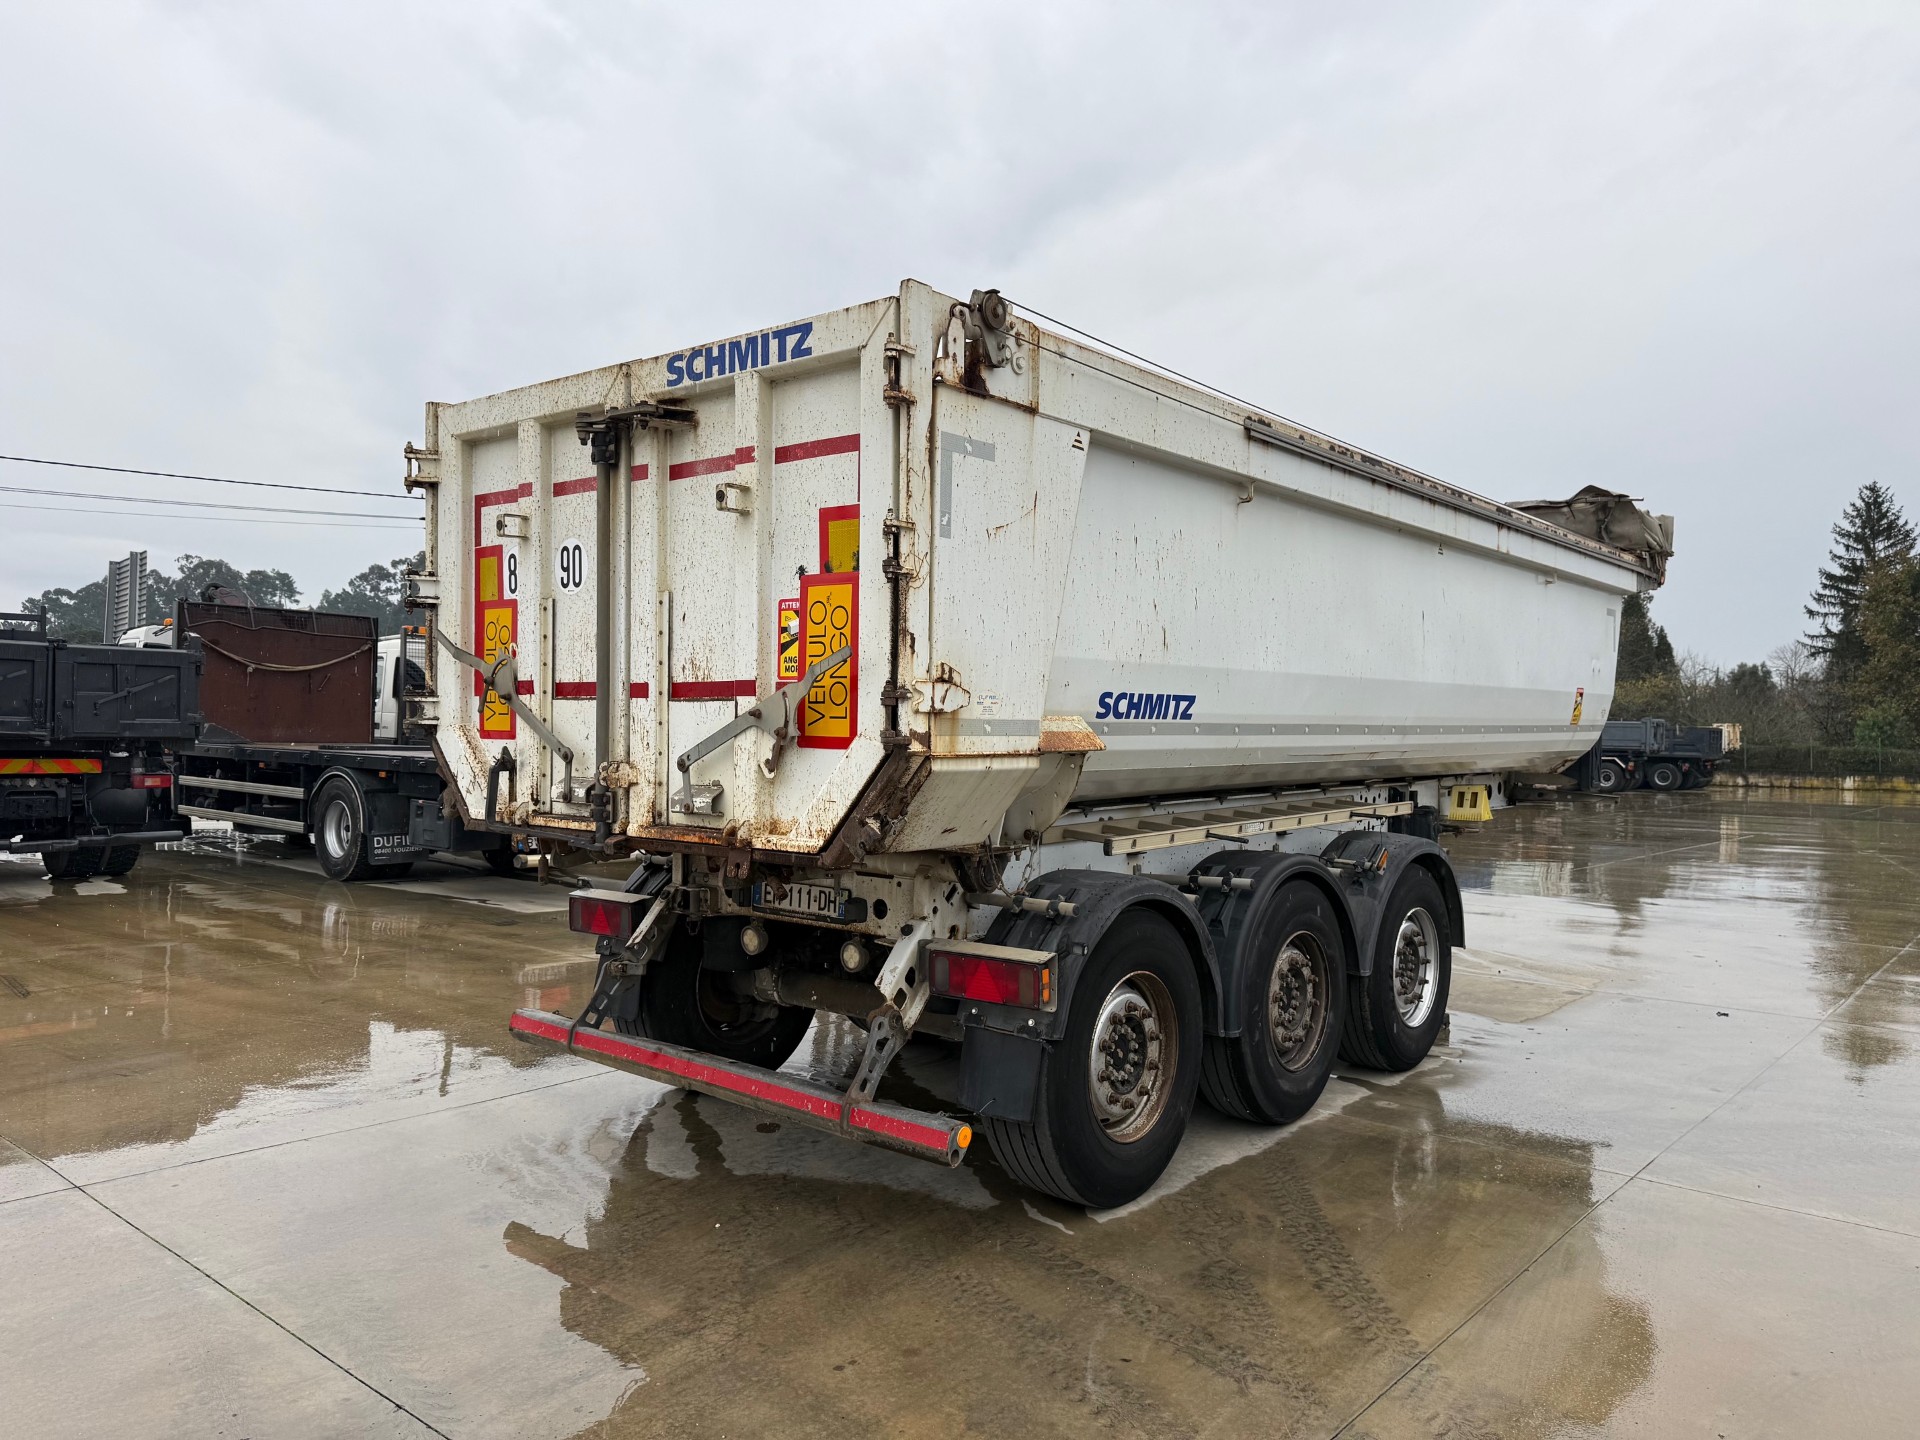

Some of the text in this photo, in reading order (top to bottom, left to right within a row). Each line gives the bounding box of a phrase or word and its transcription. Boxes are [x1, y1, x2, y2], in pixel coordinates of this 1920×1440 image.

[666, 321, 813, 388] SCHMITZ
[560, 544, 582, 589] 90
[828, 604, 850, 720] LONGO
[1095, 691, 1197, 721] SCHMITZ
